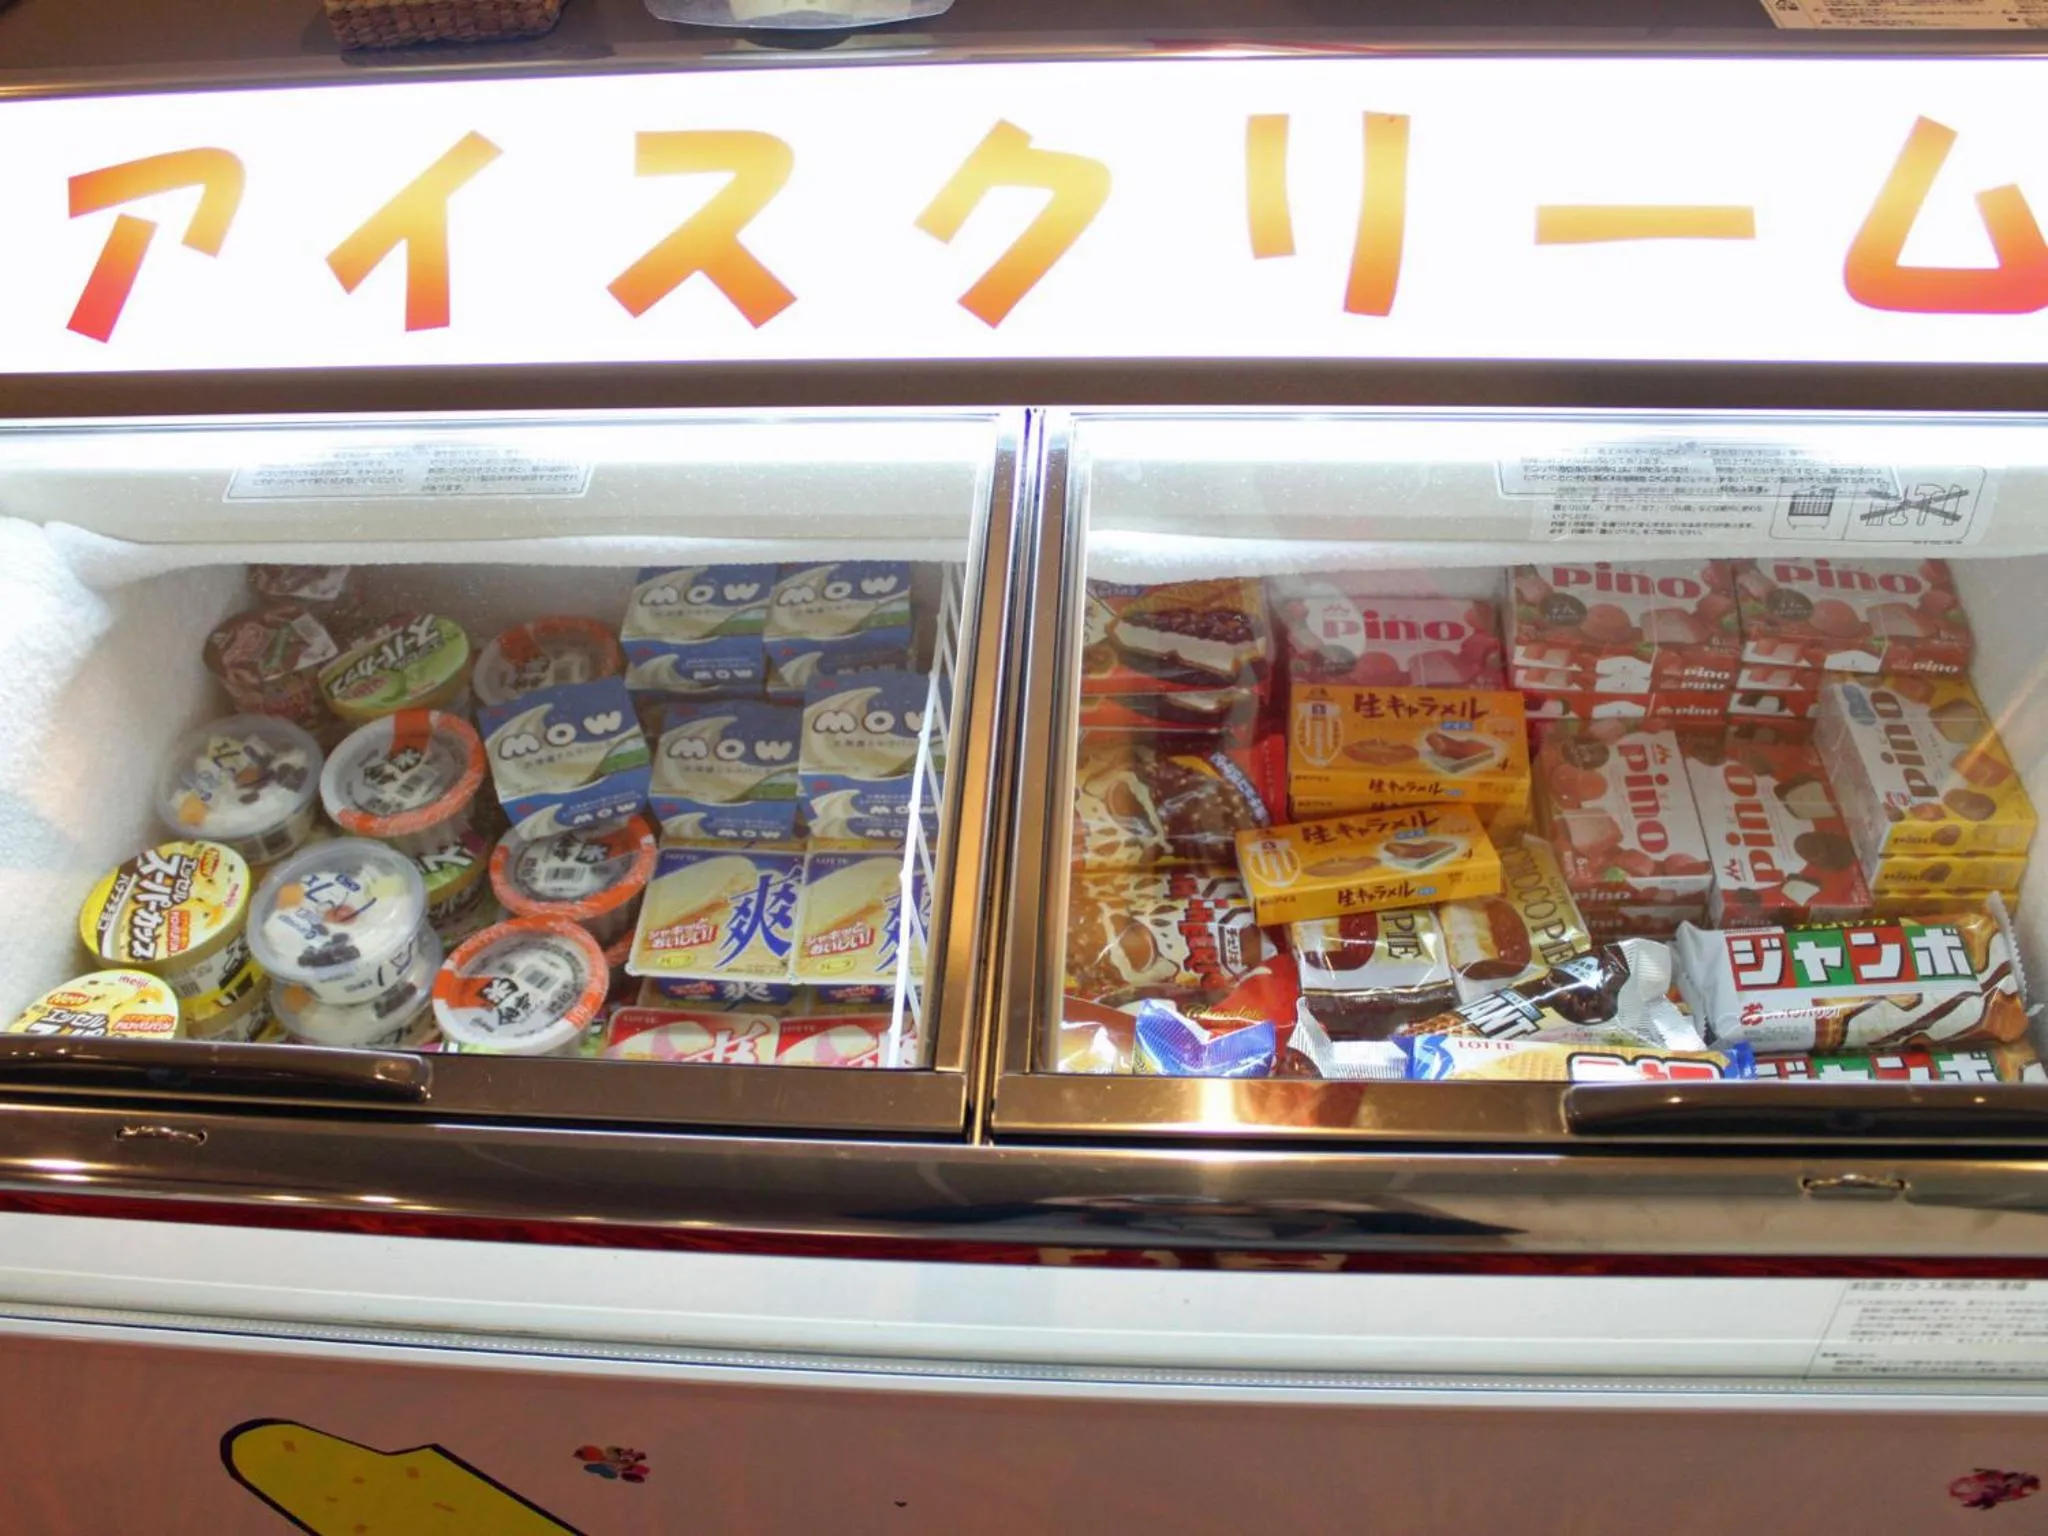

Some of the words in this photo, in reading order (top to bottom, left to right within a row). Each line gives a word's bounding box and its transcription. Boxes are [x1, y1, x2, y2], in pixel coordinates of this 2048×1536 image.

[66, 110, 2048, 344] アイスクリーム
[640, 582, 760, 606] MOW
[776, 575, 898, 606] MOW
[1553, 562, 1701, 598] pino
[1774, 558, 1922, 594] pino
[1322, 610, 1466, 641] pino
[1353, 691, 1489, 720] 生キャラメル
[498, 710, 622, 760] MOW
[667, 736, 792, 761] MOW
[1617, 743, 1670, 853] pino
[717, 829, 782, 840] MOW
[1302, 810, 1440, 846] 生キャラメル
[1723, 764, 1785, 883] pino
[132, 850, 182, 960] スーパーカップ
[1337, 880, 1416, 907] 生キャラメル
[714, 872, 800, 969] 爽
[1381, 912, 1423, 960] PIE
[1731, 928, 1973, 986] ジャンボ
[1458, 1040, 1516, 1050] LOTTE
